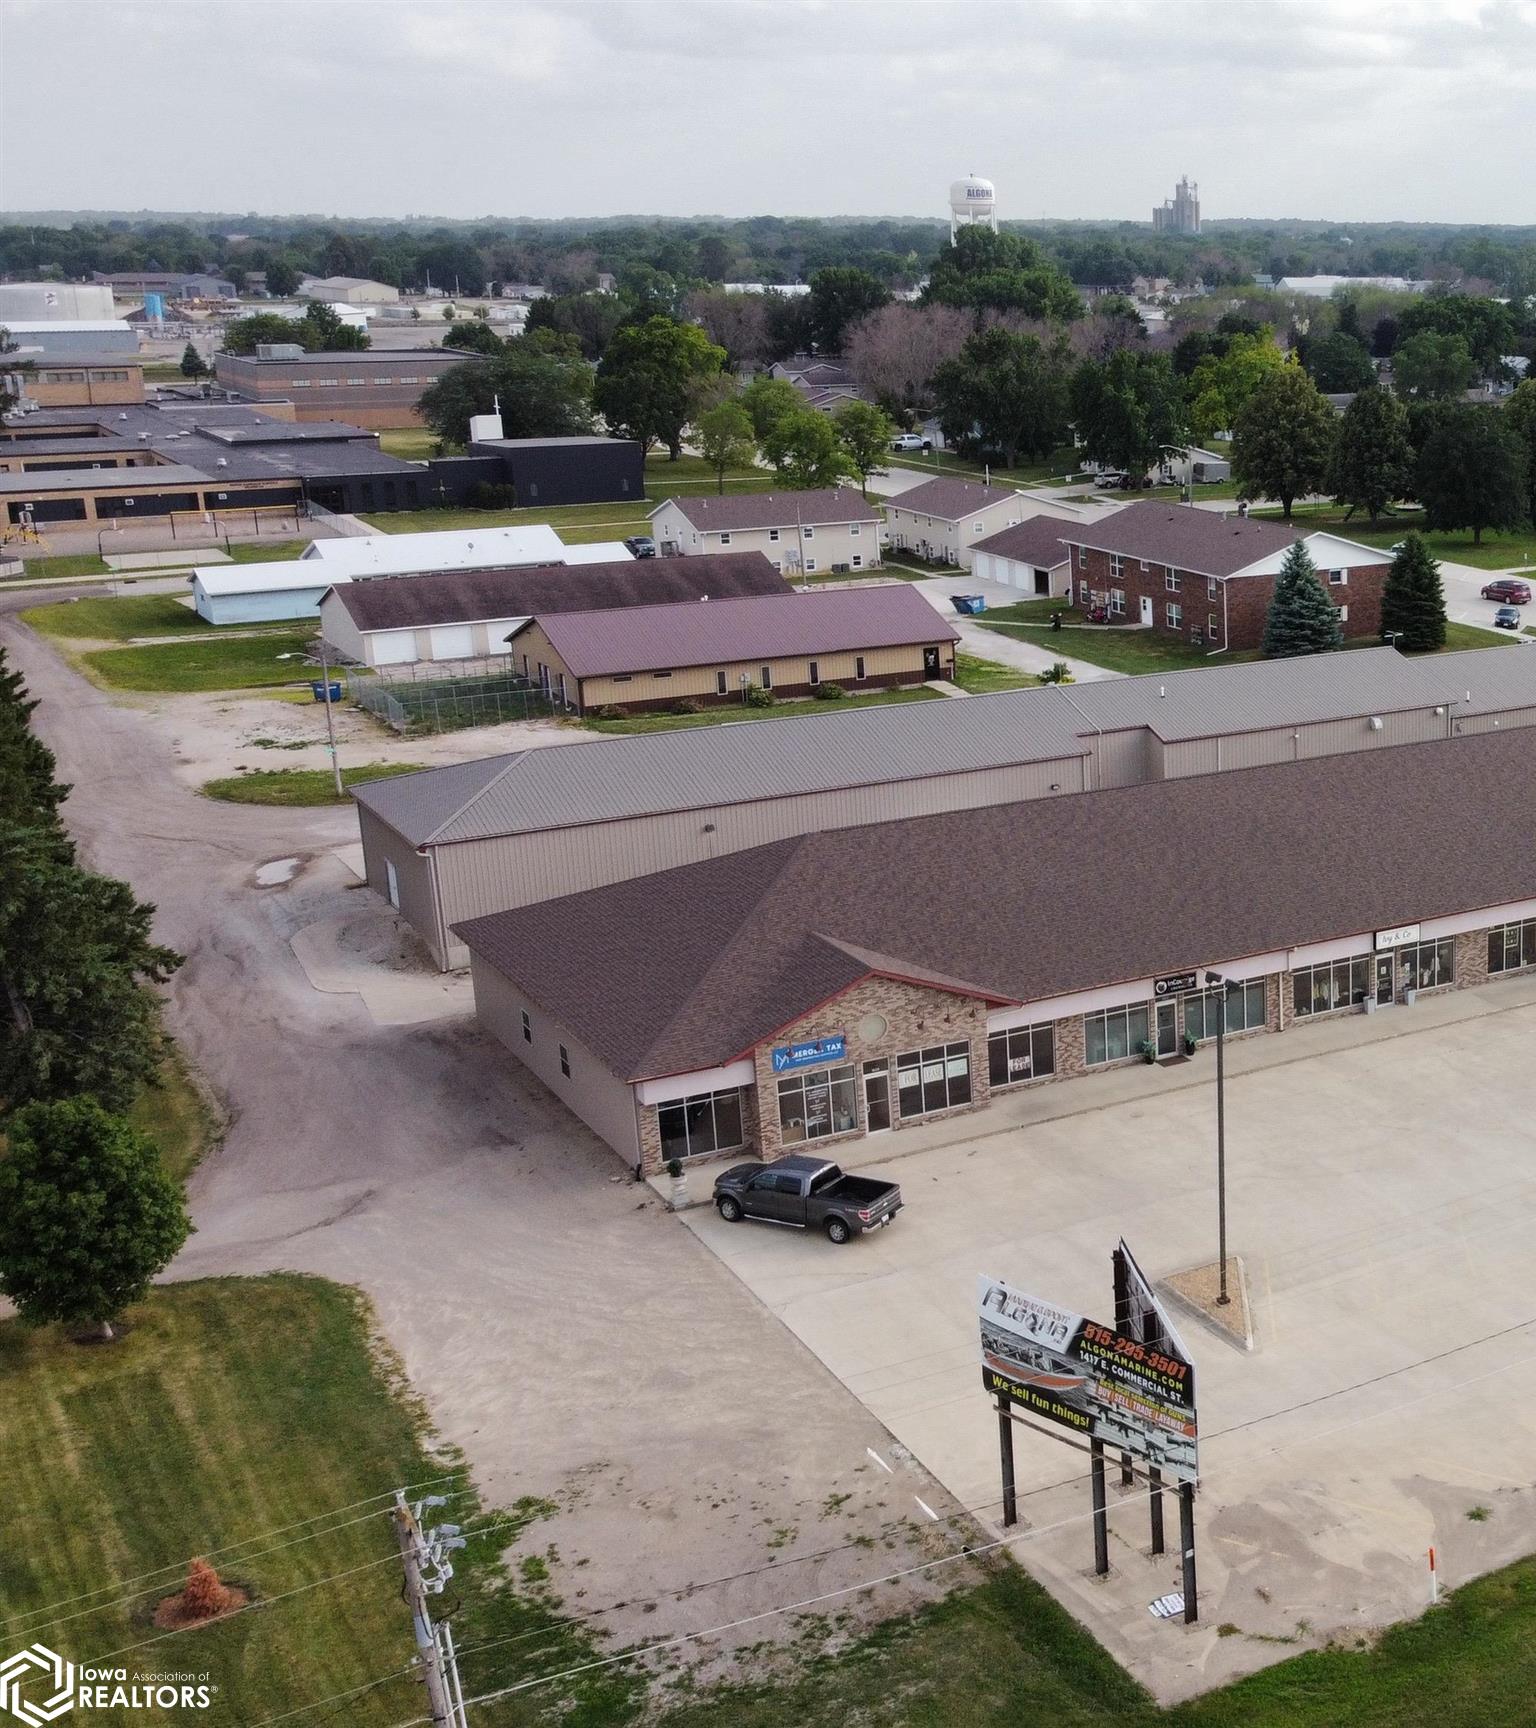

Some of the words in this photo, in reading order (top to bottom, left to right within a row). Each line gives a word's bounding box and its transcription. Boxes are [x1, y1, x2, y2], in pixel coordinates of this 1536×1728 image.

[826, 1043, 842, 1051] TAX
[982, 1286, 1068, 1340] ALGONA
[1080, 1339, 1184, 1391] ALGONAMARINE.COM
[1080, 1350, 1098, 1365] 1417
[1101, 1360, 1109, 1370] E.
[1112, 1364, 1168, 1398] COMMERCIAL
[1170, 1391, 1184, 1404] ST.
[992, 1374, 1009, 1391] We
[1011, 1385, 1029, 1401] sell
[1052, 1402, 1089, 1428] things!
[1097, 1386, 1111, 1399] BUY
[1114, 1394, 1130, 1408] SELL
[1133, 1401, 1153, 1419] TRADE
